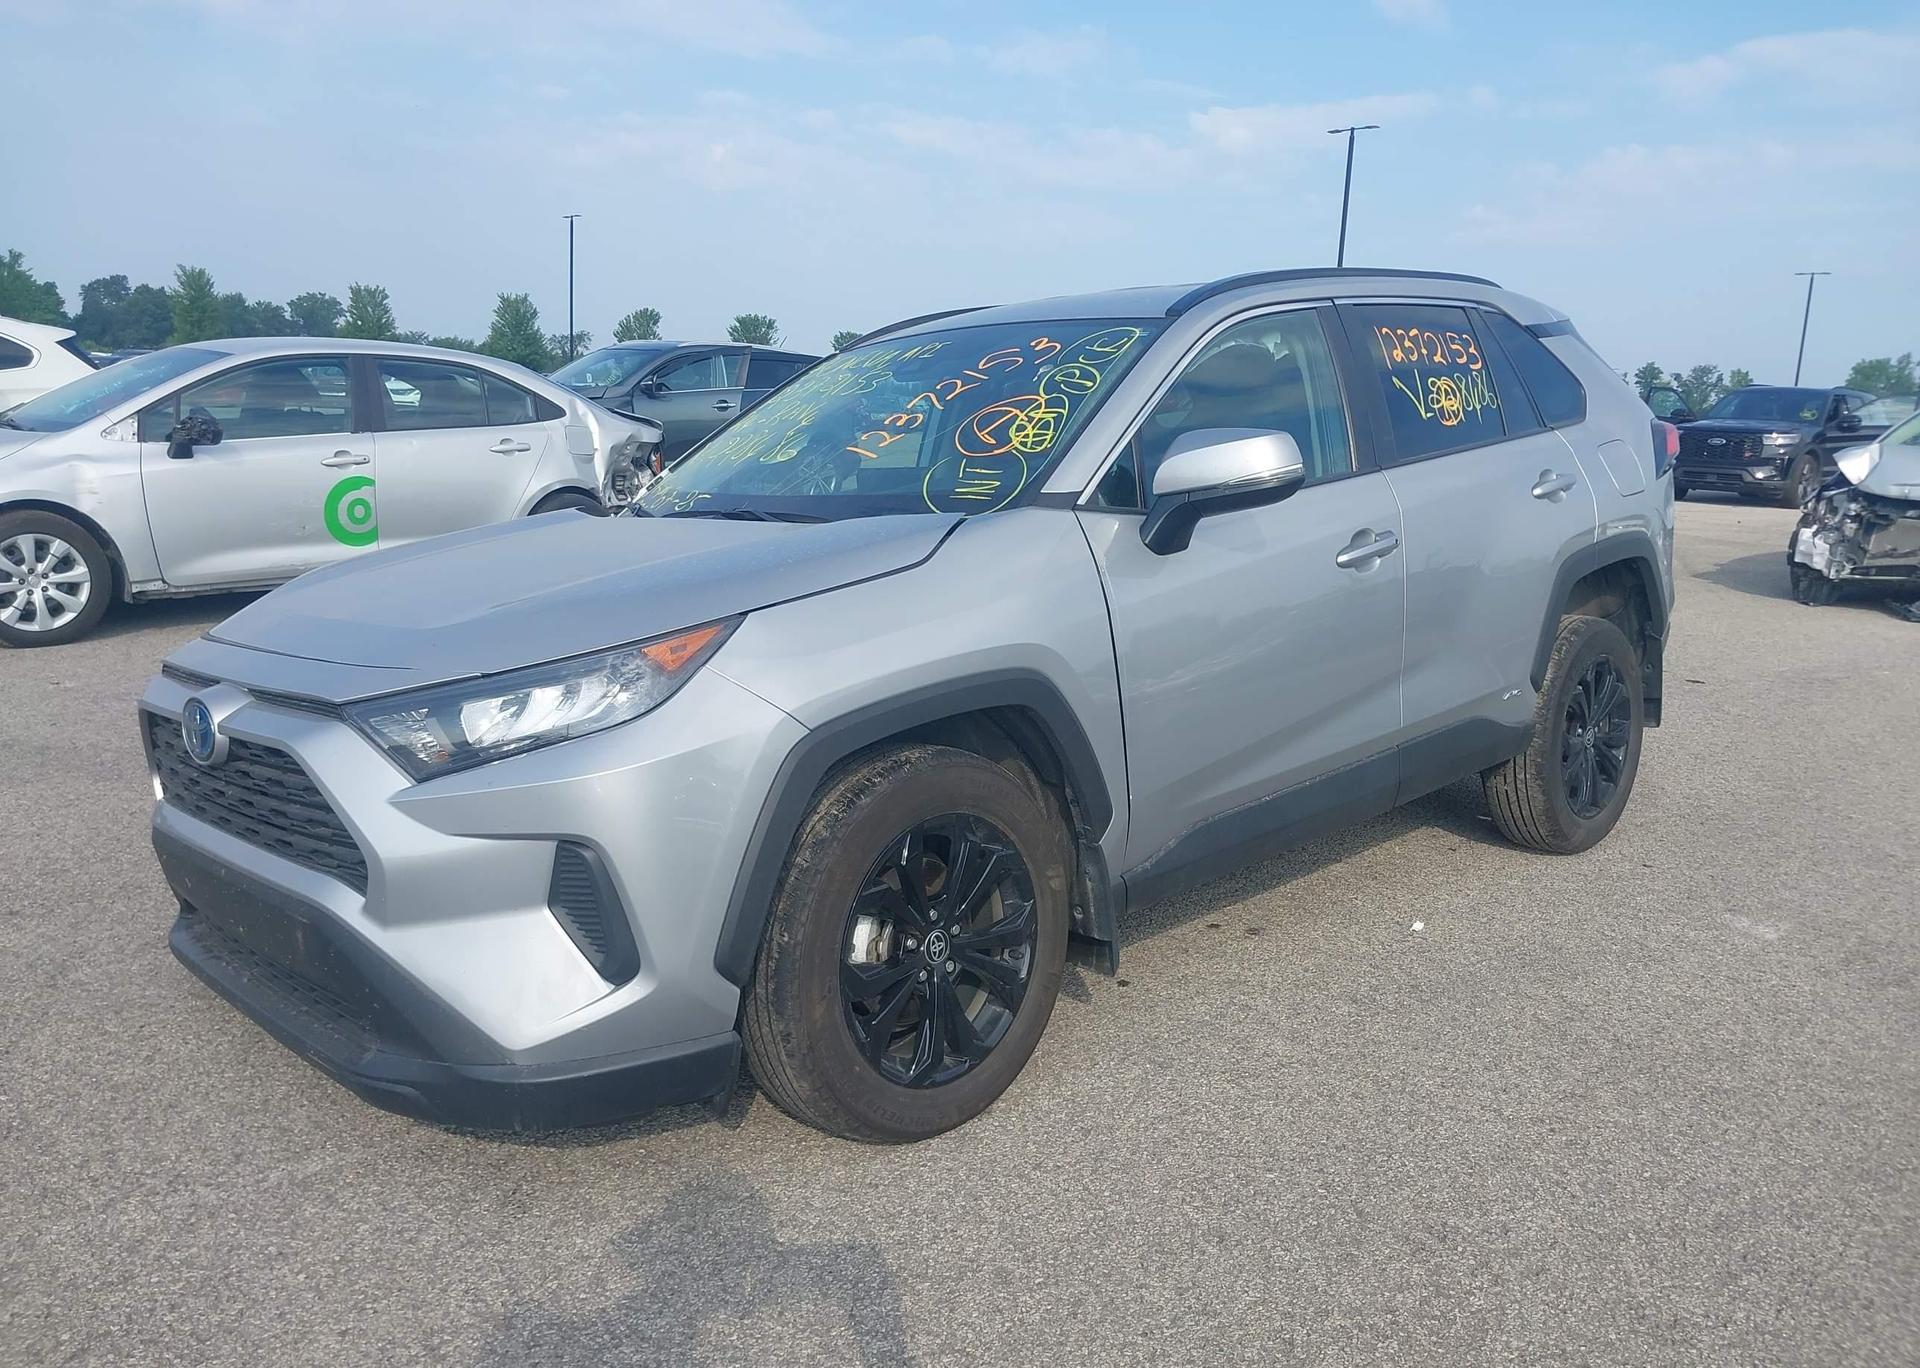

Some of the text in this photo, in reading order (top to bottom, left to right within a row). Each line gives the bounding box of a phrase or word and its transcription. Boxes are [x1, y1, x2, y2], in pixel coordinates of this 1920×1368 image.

[1373, 324, 1482, 370] 12372153
[846, 336, 1062, 459] 12372153
[949, 457, 1004, 500] INT
